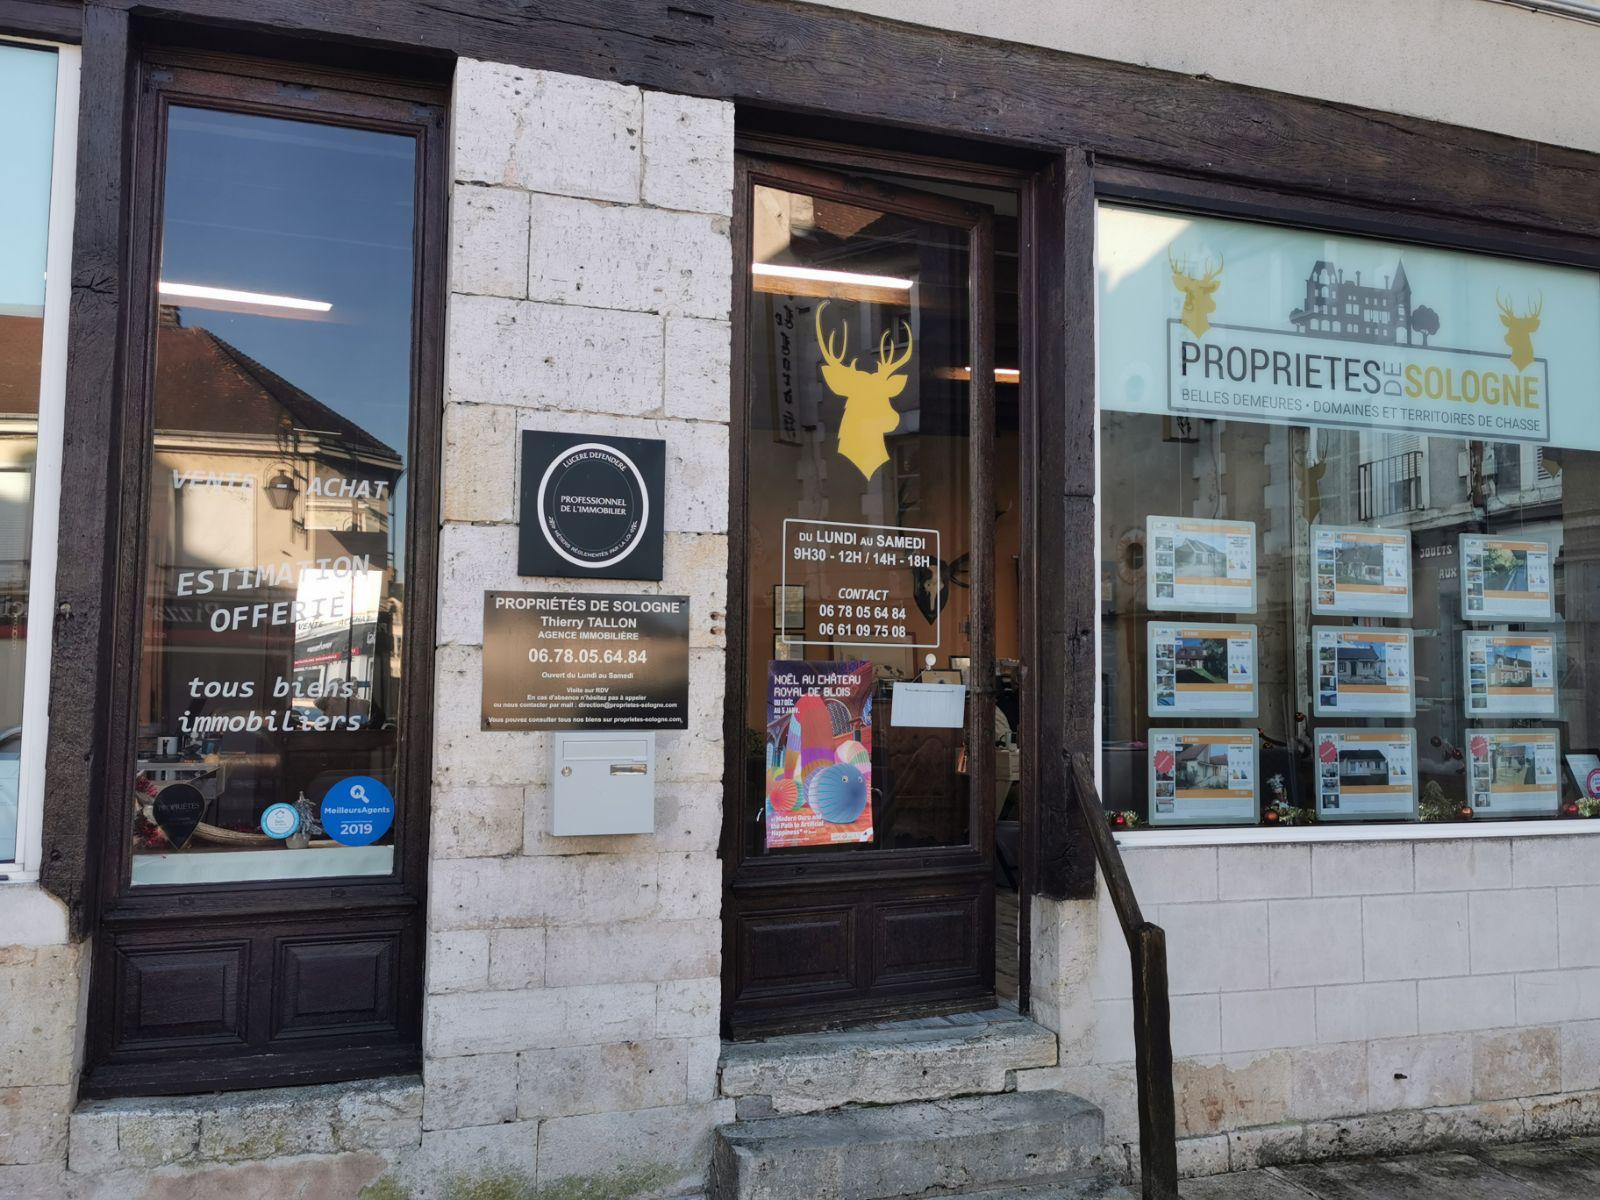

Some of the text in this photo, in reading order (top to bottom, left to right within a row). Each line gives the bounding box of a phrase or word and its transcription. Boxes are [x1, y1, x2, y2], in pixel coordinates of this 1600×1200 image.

[1181, 341, 1381, 394] PROPRIETES
[1383, 361, 1402, 396] DE
[1404, 364, 1540, 409] SOLOGNE
[1182, 388, 1540, 431] BELLES DEMEURES DOMAINES ET TERRITOIRES DE CHASSE
[172, 469, 389, 500] VENTE ACHAT
[560, 495, 627, 507] PROFESSIONNEL
[560, 504, 626, 515] DE L'IMMOBILIER
[799, 530, 926, 550] DU LUNDI AU SAMEDI
[794, 548, 826, 561] 9H30
[838, 550, 862, 564] 12H
[872, 552, 896, 566] 14H
[908, 554, 930, 568] 18H
[176, 554, 370, 597] ESTIMATION
[838, 587, 889, 601] CONTACT
[495, 596, 680, 614] PROPRIÉTÉS DE SOLOGNE
[819, 604, 906, 620] 06 78 05 64 84
[540, 616, 636, 630] Thierry TALLON
[818, 623, 906, 638] 06 61 09 75 08
[538, 630, 639, 640] AGENCE IMMOBILIÈRE
[528, 648, 648, 664] 06.78.05.64.84
[188, 676, 354, 698] tous biens
[802, 674, 815, 684] AU
[774, 687, 850, 697] ROYAL DE BLOIS
[178, 710, 361, 734] immobiliers
[324, 805, 390, 816] MeilleursAgents
[340, 823, 374, 836] 2019
